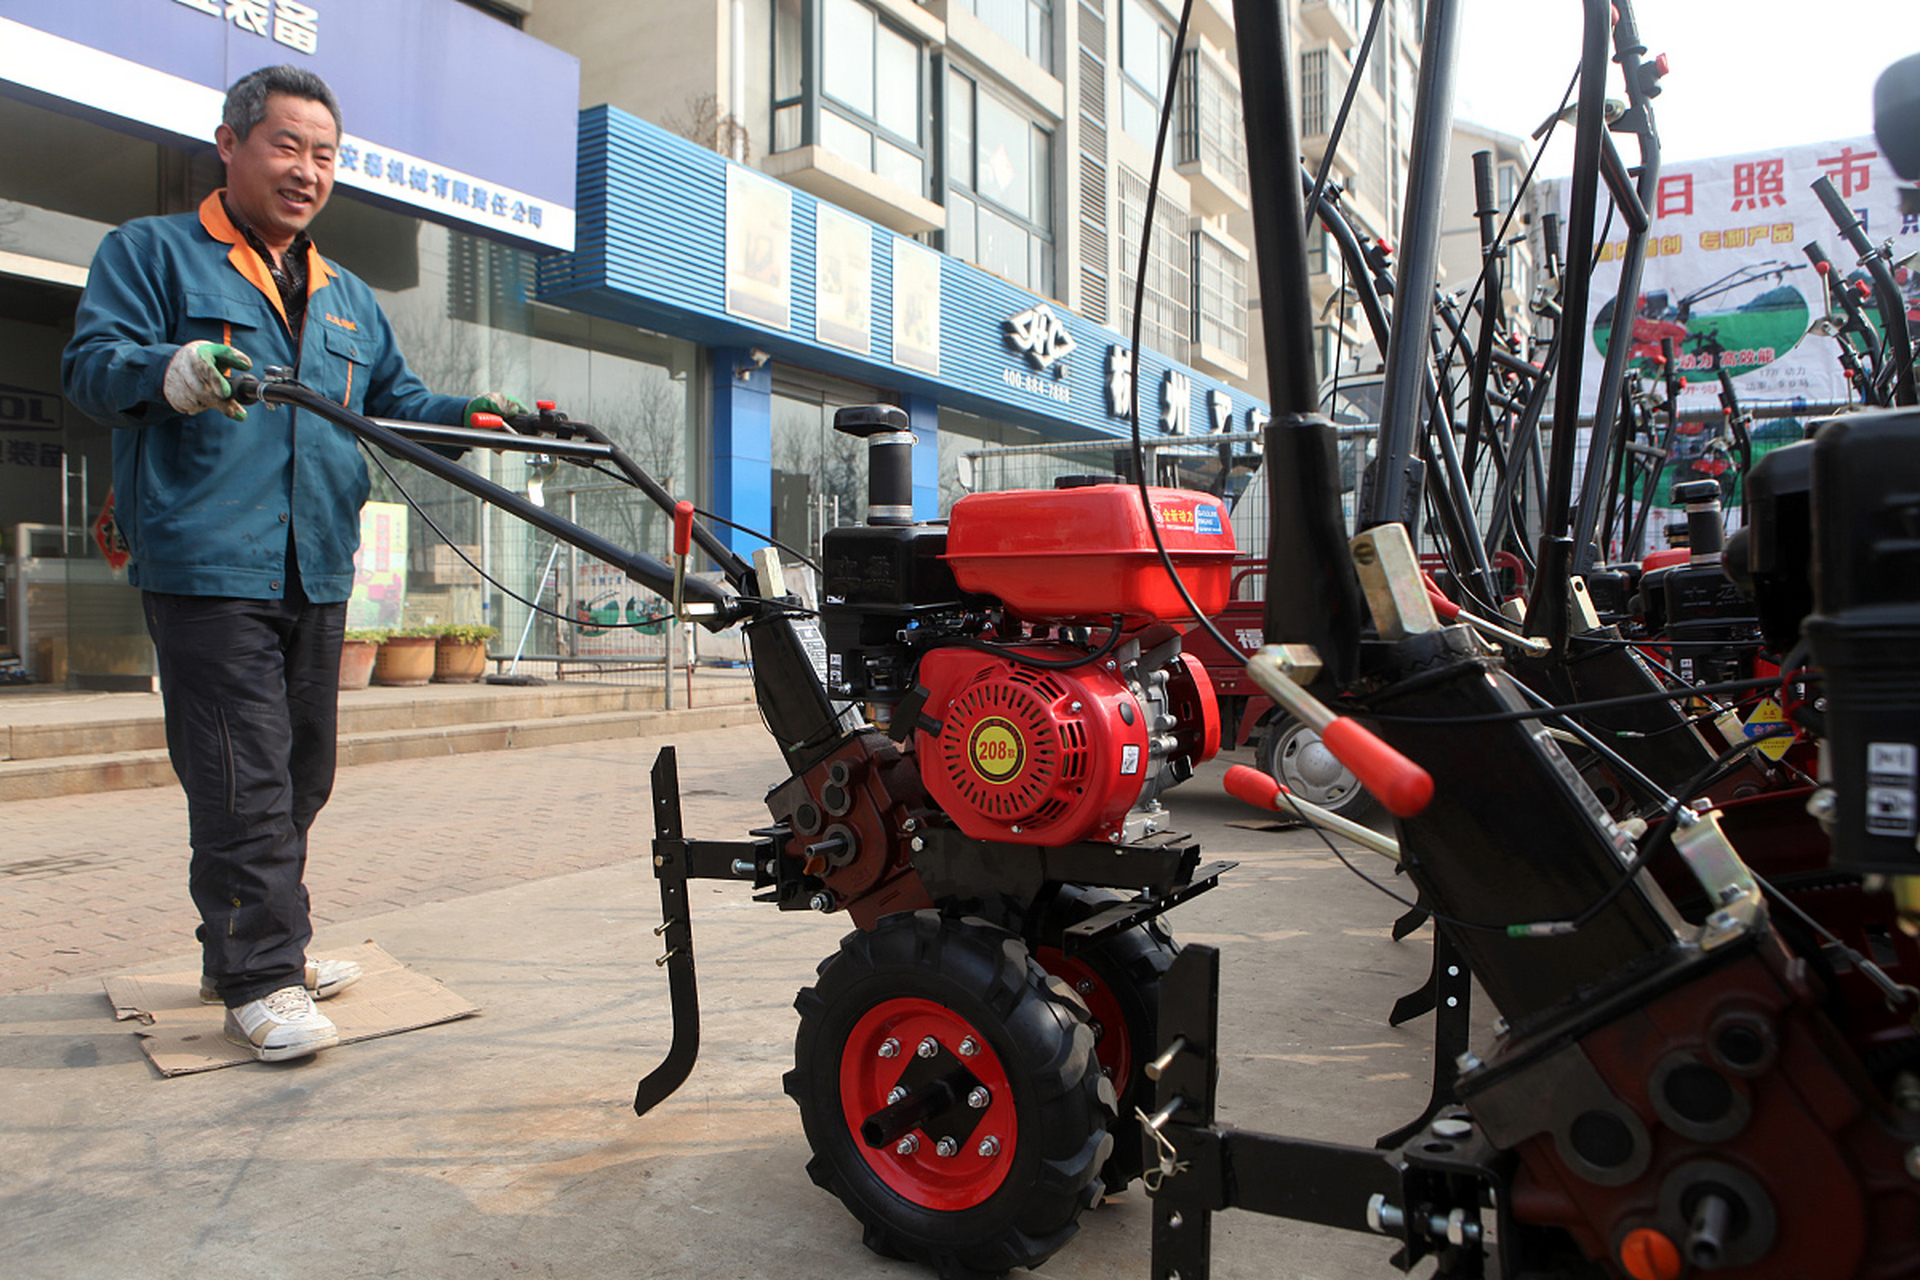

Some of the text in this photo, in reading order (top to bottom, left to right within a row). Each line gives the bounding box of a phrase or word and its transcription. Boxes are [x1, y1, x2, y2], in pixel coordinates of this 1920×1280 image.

[171, 0, 319, 56] 装备
[338, 144, 543, 229] 安泰机械有限责任公司
[1699, 222, 1795, 252] 专利产品
[1674, 346, 1776, 371] 动力 高效能
[0, 439, 65, 468] 装备
